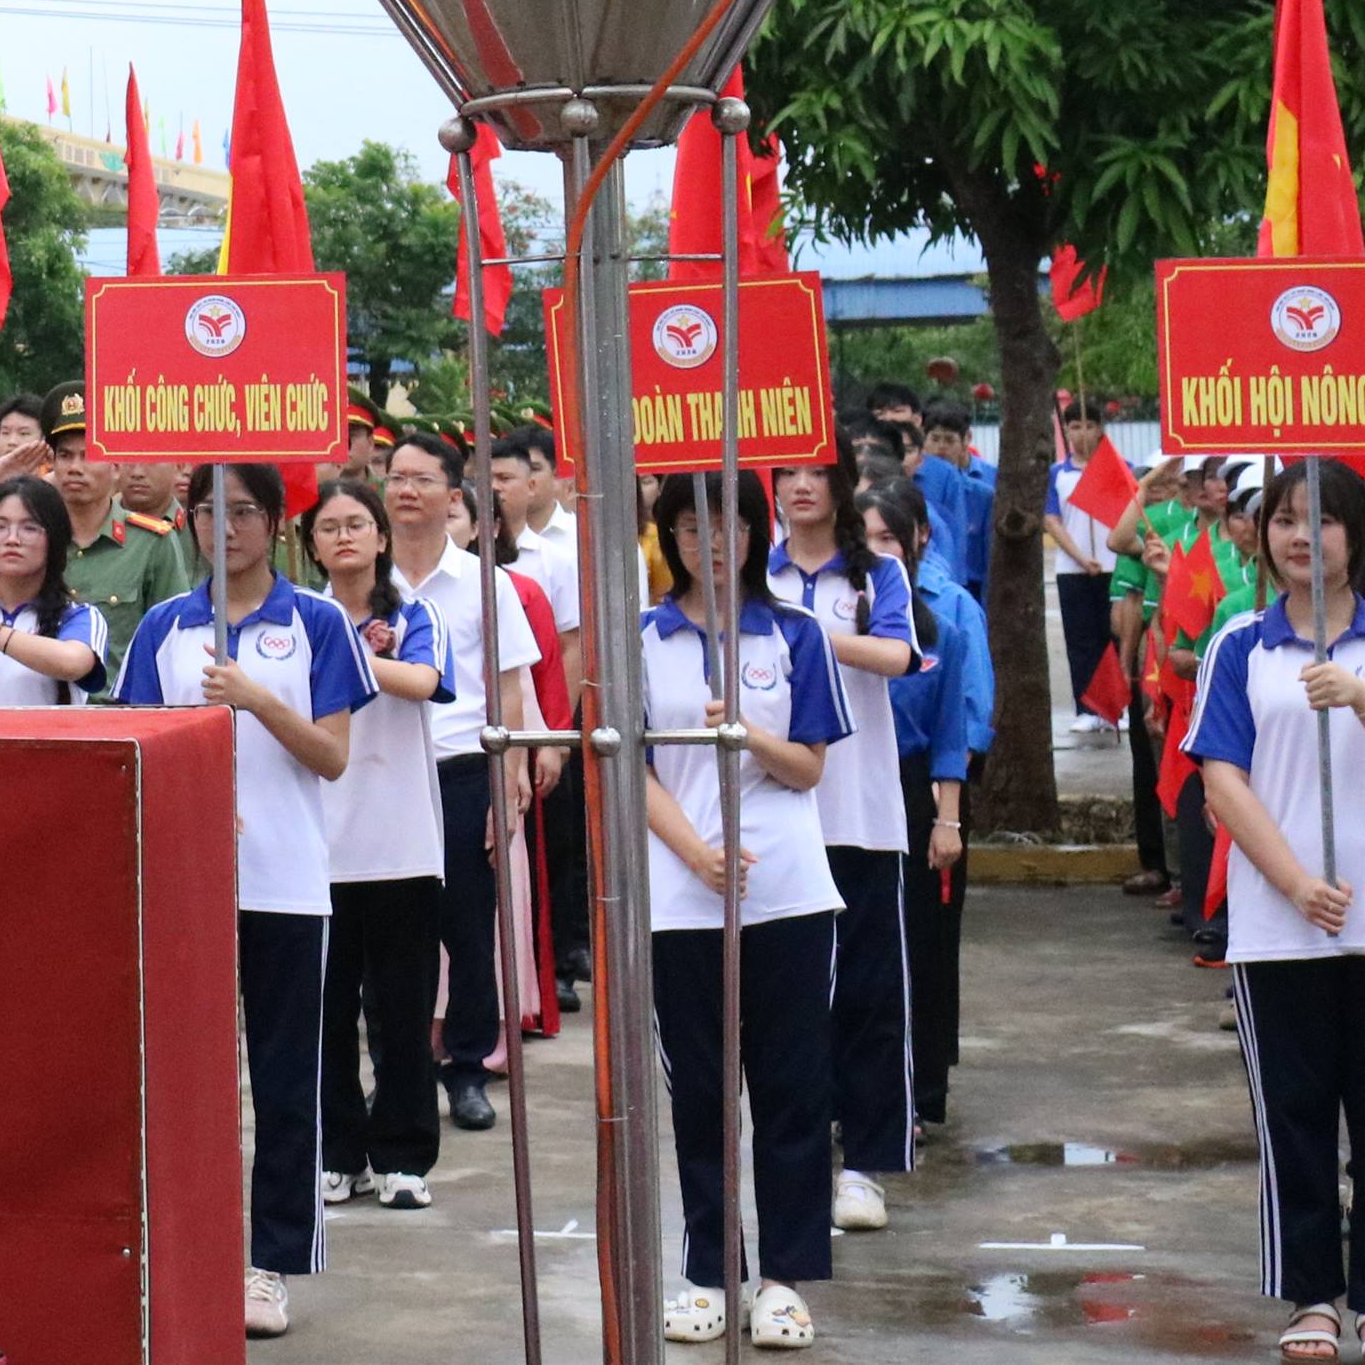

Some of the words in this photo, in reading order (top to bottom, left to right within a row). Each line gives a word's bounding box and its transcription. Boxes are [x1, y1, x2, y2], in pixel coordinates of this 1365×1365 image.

[103, 368, 142, 433] KHỐI
[145, 374, 189, 433] CÔNG
[193, 373, 241, 438] CHỨC,
[244, 373, 283, 432] VIÊN
[285, 373, 329, 432] CHỨC
[760, 377, 813, 437] NIÊN
[1181, 358, 1243, 427] KHỐI
[1249, 364, 1294, 438] HỘI
